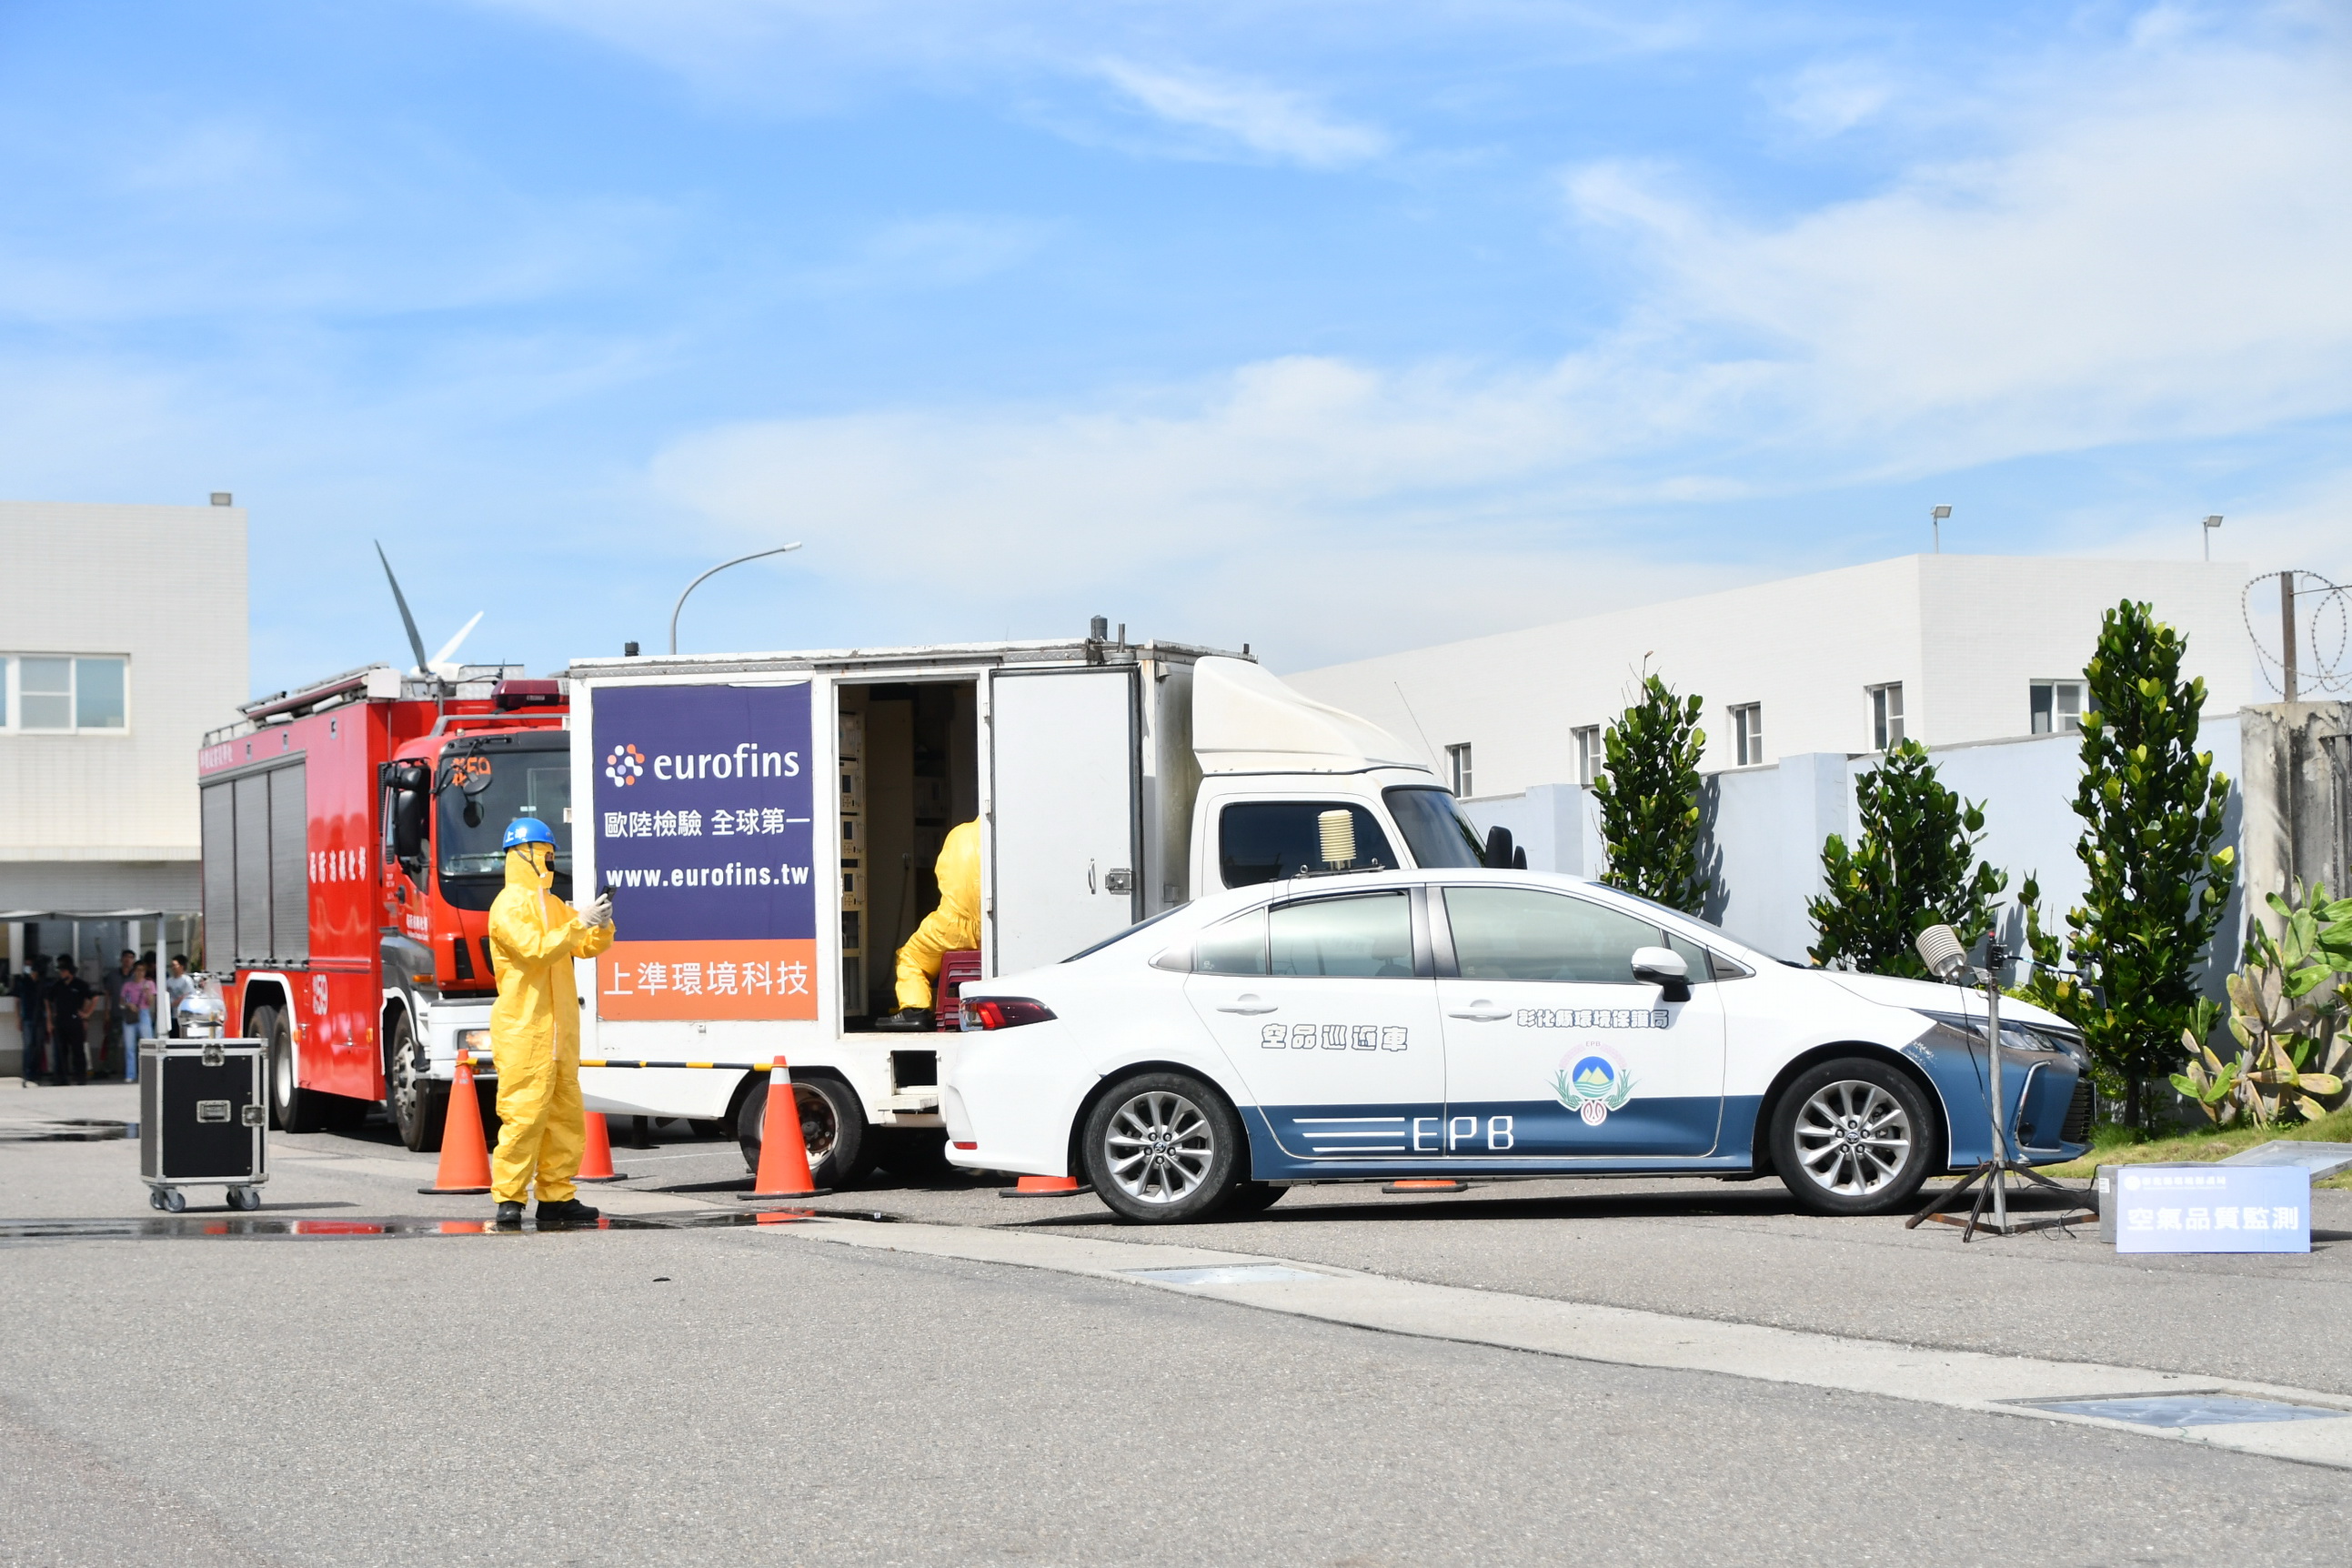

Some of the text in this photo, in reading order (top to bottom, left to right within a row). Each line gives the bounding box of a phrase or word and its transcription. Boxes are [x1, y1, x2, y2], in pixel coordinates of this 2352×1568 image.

[653, 742, 800, 780] eurofins
[604, 807, 810, 839] 歐陸檢驗 全球第一
[606, 862, 809, 889] www.eurofins.tw
[603, 960, 809, 996] 上準環境科技
[1412, 1115, 1514, 1151] EPB
[2126, 1206, 2299, 1231] 空氣品質監測
